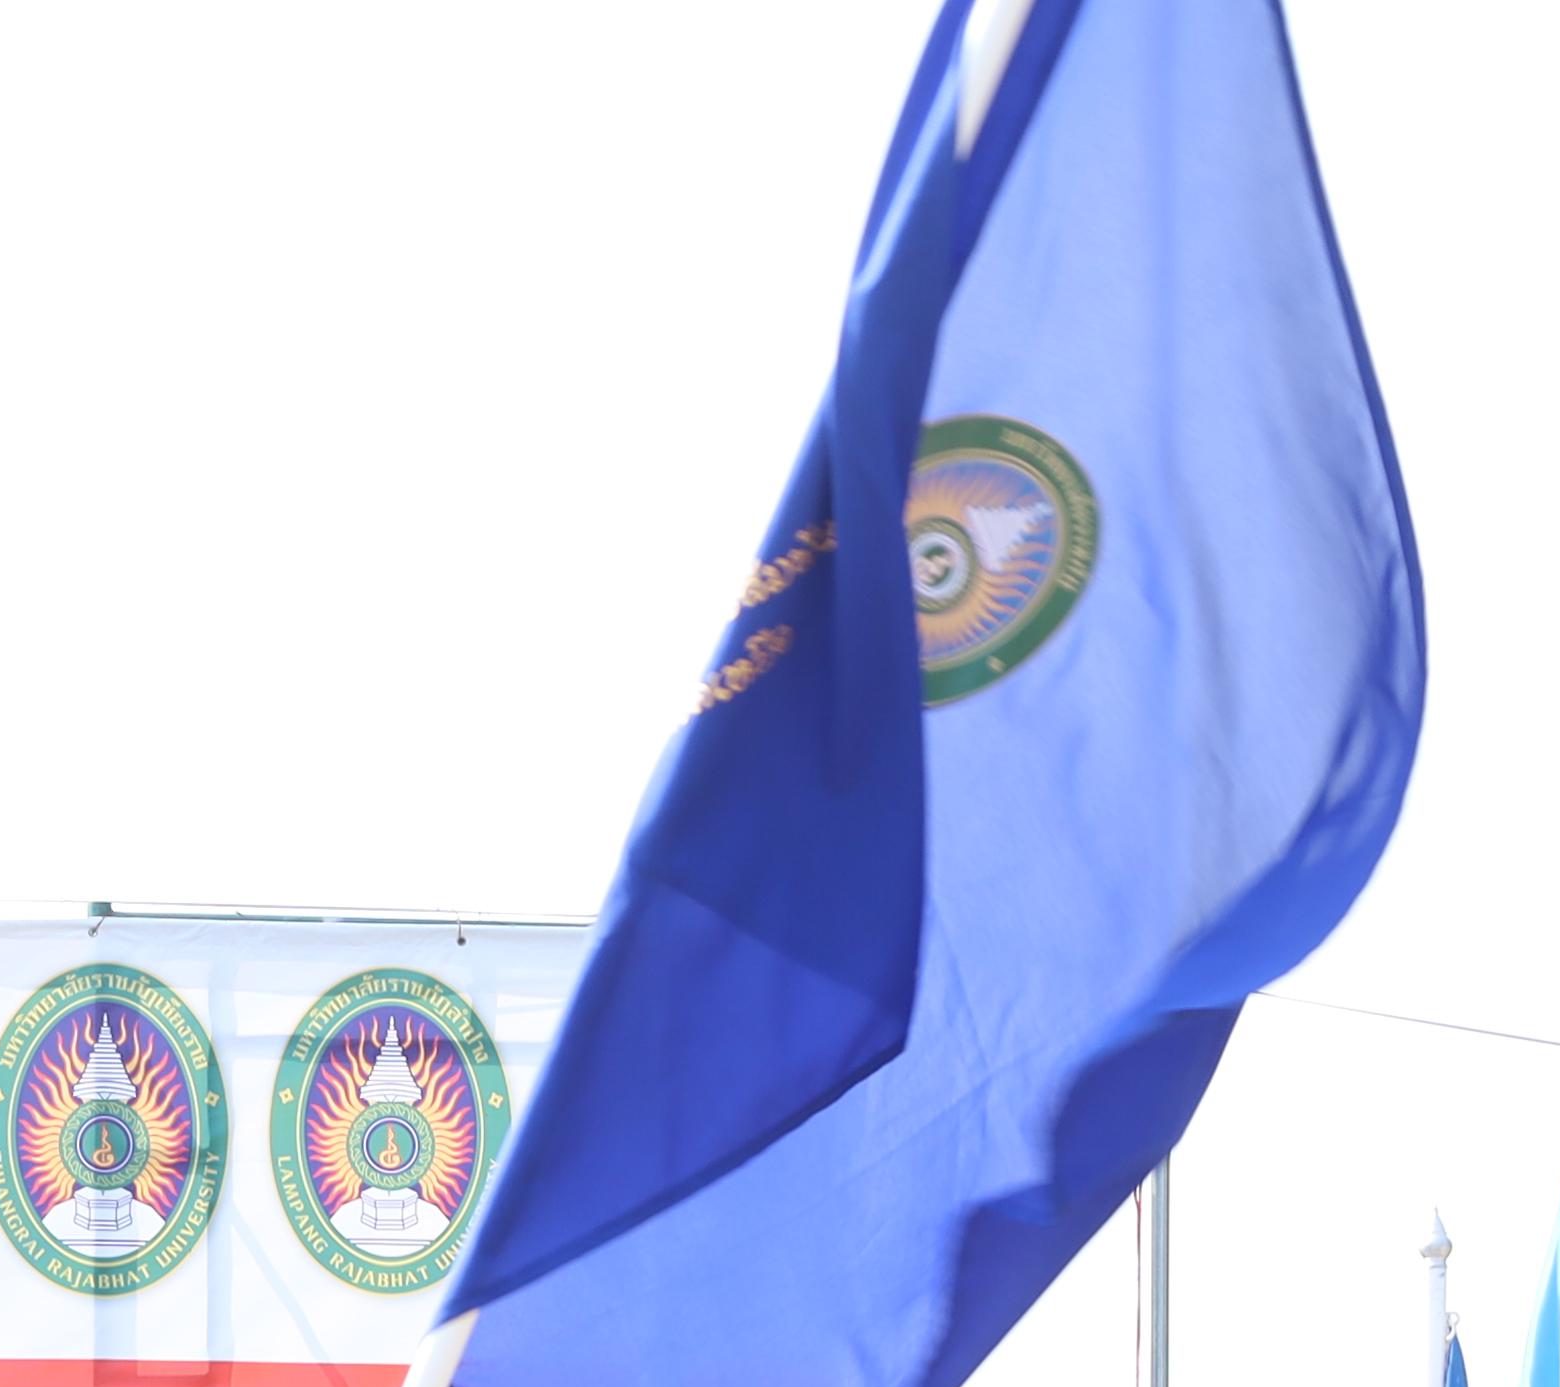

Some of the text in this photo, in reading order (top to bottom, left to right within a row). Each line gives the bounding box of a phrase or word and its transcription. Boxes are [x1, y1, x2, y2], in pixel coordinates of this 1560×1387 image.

[47, 1260, 151, 1289] RAJABHAT
[155, 1151, 221, 1269] UNIVERSITY
[278, 1154, 431, 1288] LAMPANG RAJABHAT
